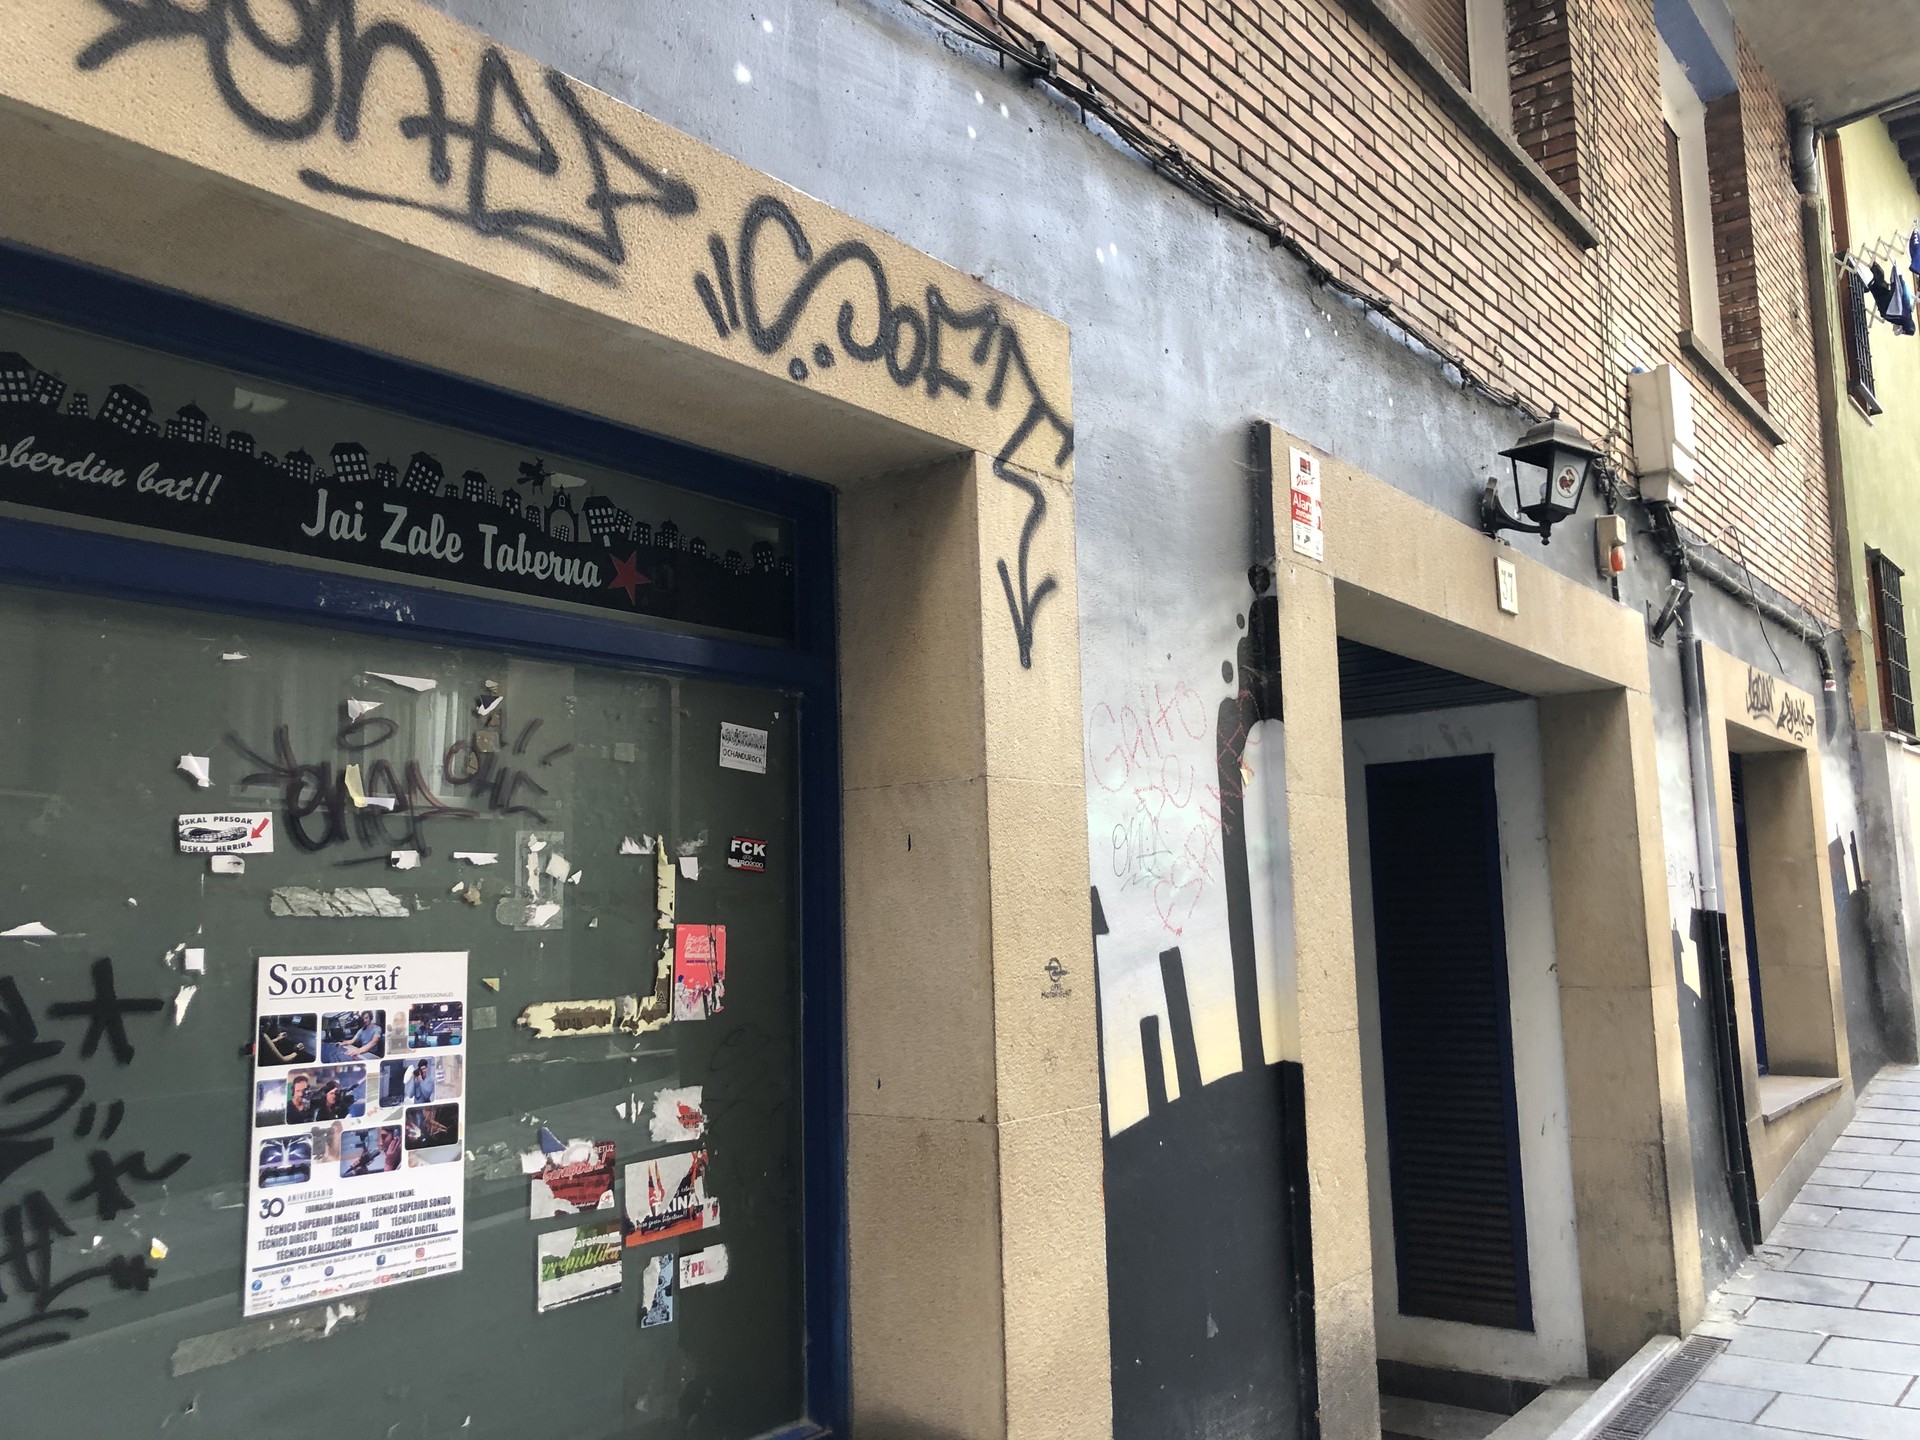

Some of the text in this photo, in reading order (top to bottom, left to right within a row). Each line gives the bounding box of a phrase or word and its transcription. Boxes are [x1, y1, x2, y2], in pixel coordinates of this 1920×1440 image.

[137, 462, 223, 505] bat!!
[300, 488, 602, 588] Jai Zale Taberna
[213, 816, 253, 825] PRESOAK
[216, 841, 253, 852] HERRIRA
[730, 839, 767, 857] FCK
[268, 963, 401, 1000] Sonograf
[287, 1188, 334, 1202] ANIVERSARIO
[259, 1197, 285, 1220] 30
[371, 1196, 451, 1217] TÉCNICO SUPERIOR SONIDO
[265, 1211, 360, 1237] TÉCNICO SUPERIOR IMAGEN
[391, 1207, 456, 1227] TÉCNICO ILUMINACIÓN
[331, 1220, 379, 1237] TÉCNICO RADIO
[374, 1223, 439, 1243] FOTOGRAFÍA DIGITAL
[258, 1231, 317, 1250] TÉCNICO DIRECTO
[276, 1237, 352, 1261] TÉCNICO REALIZACIÓN
